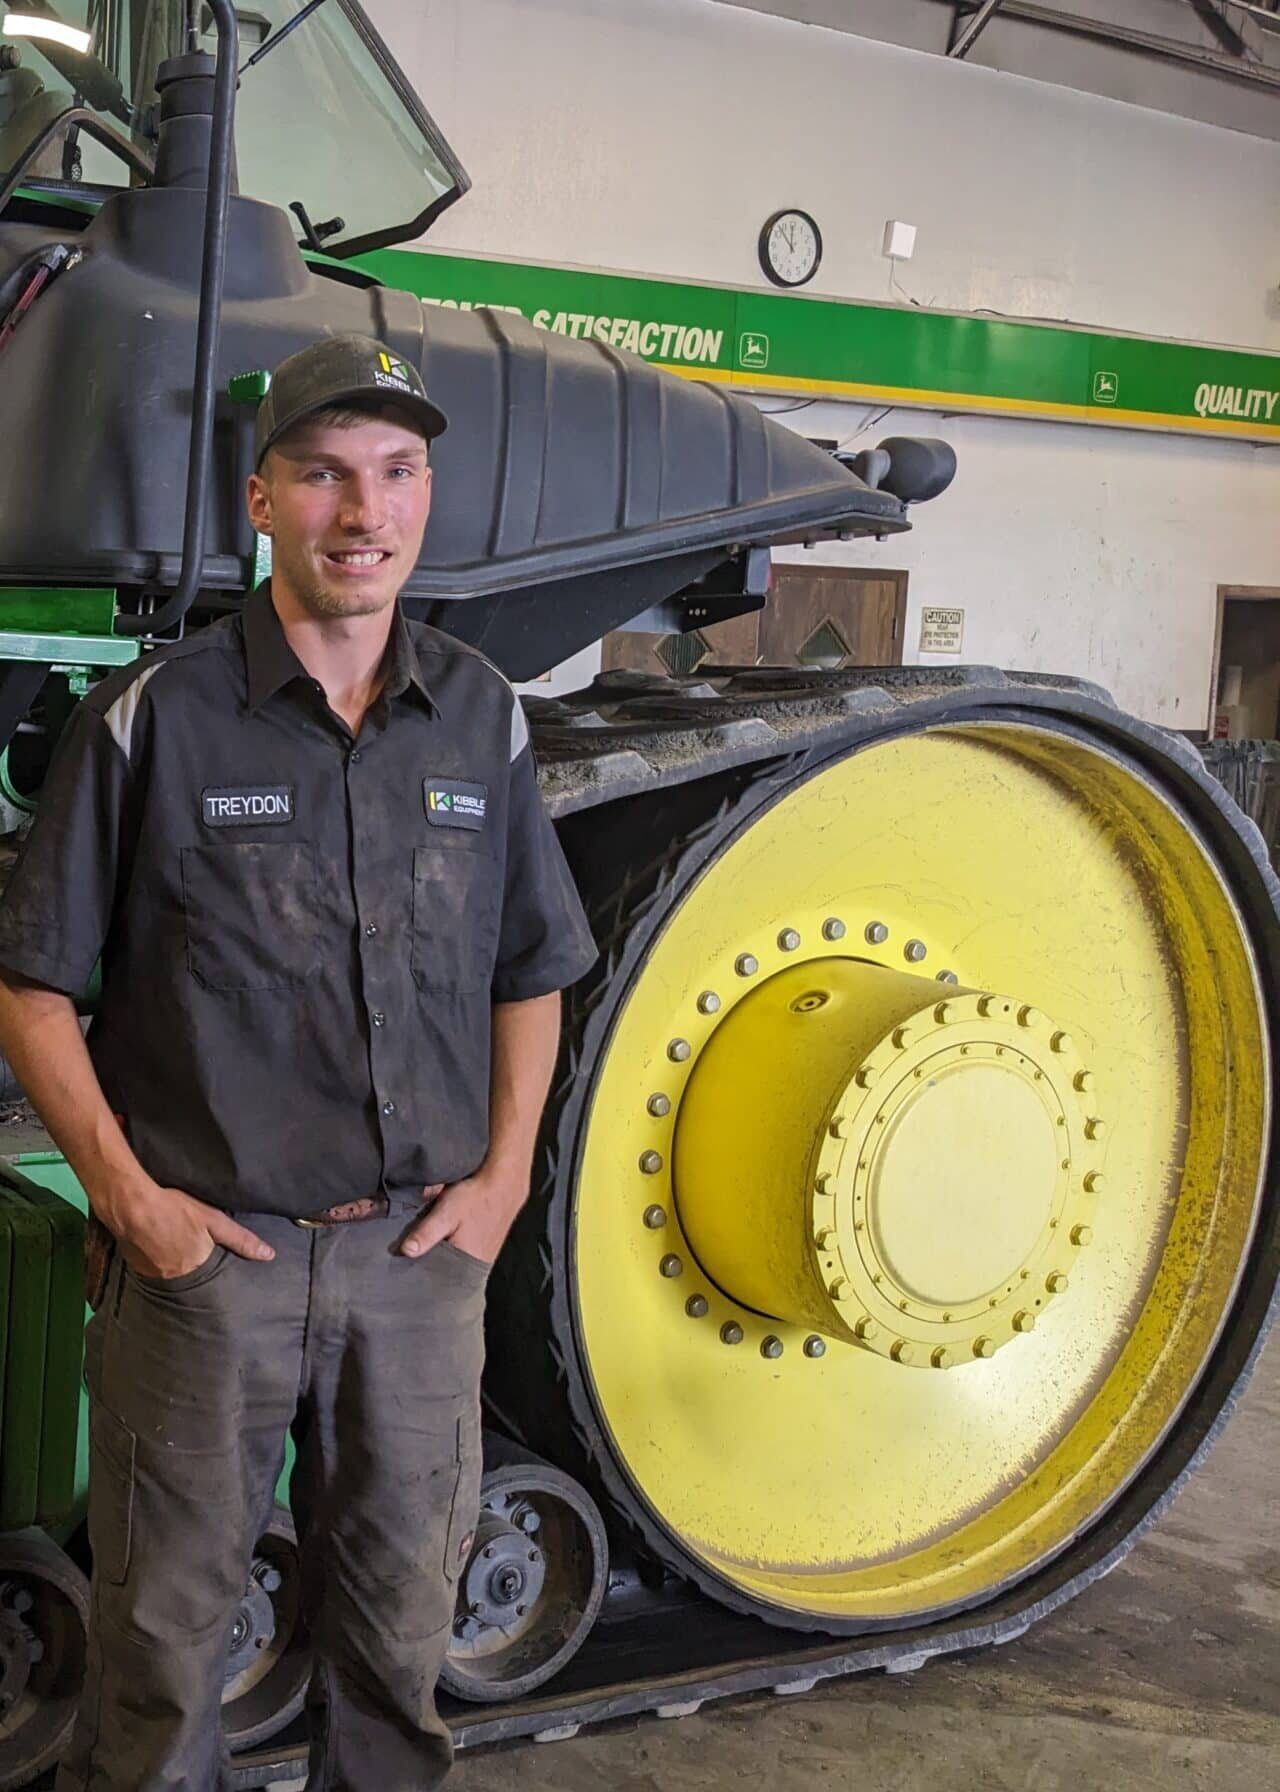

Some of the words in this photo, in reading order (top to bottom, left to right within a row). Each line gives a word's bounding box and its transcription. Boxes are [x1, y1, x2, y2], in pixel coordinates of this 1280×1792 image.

[533, 309, 724, 363] SATISFACTION
[1194, 383, 1280, 419] QUALITY
[926, 612, 959, 624] CAUTION
[206, 794, 289, 817] TREYDON
[452, 794, 487, 809] KIBBLE
